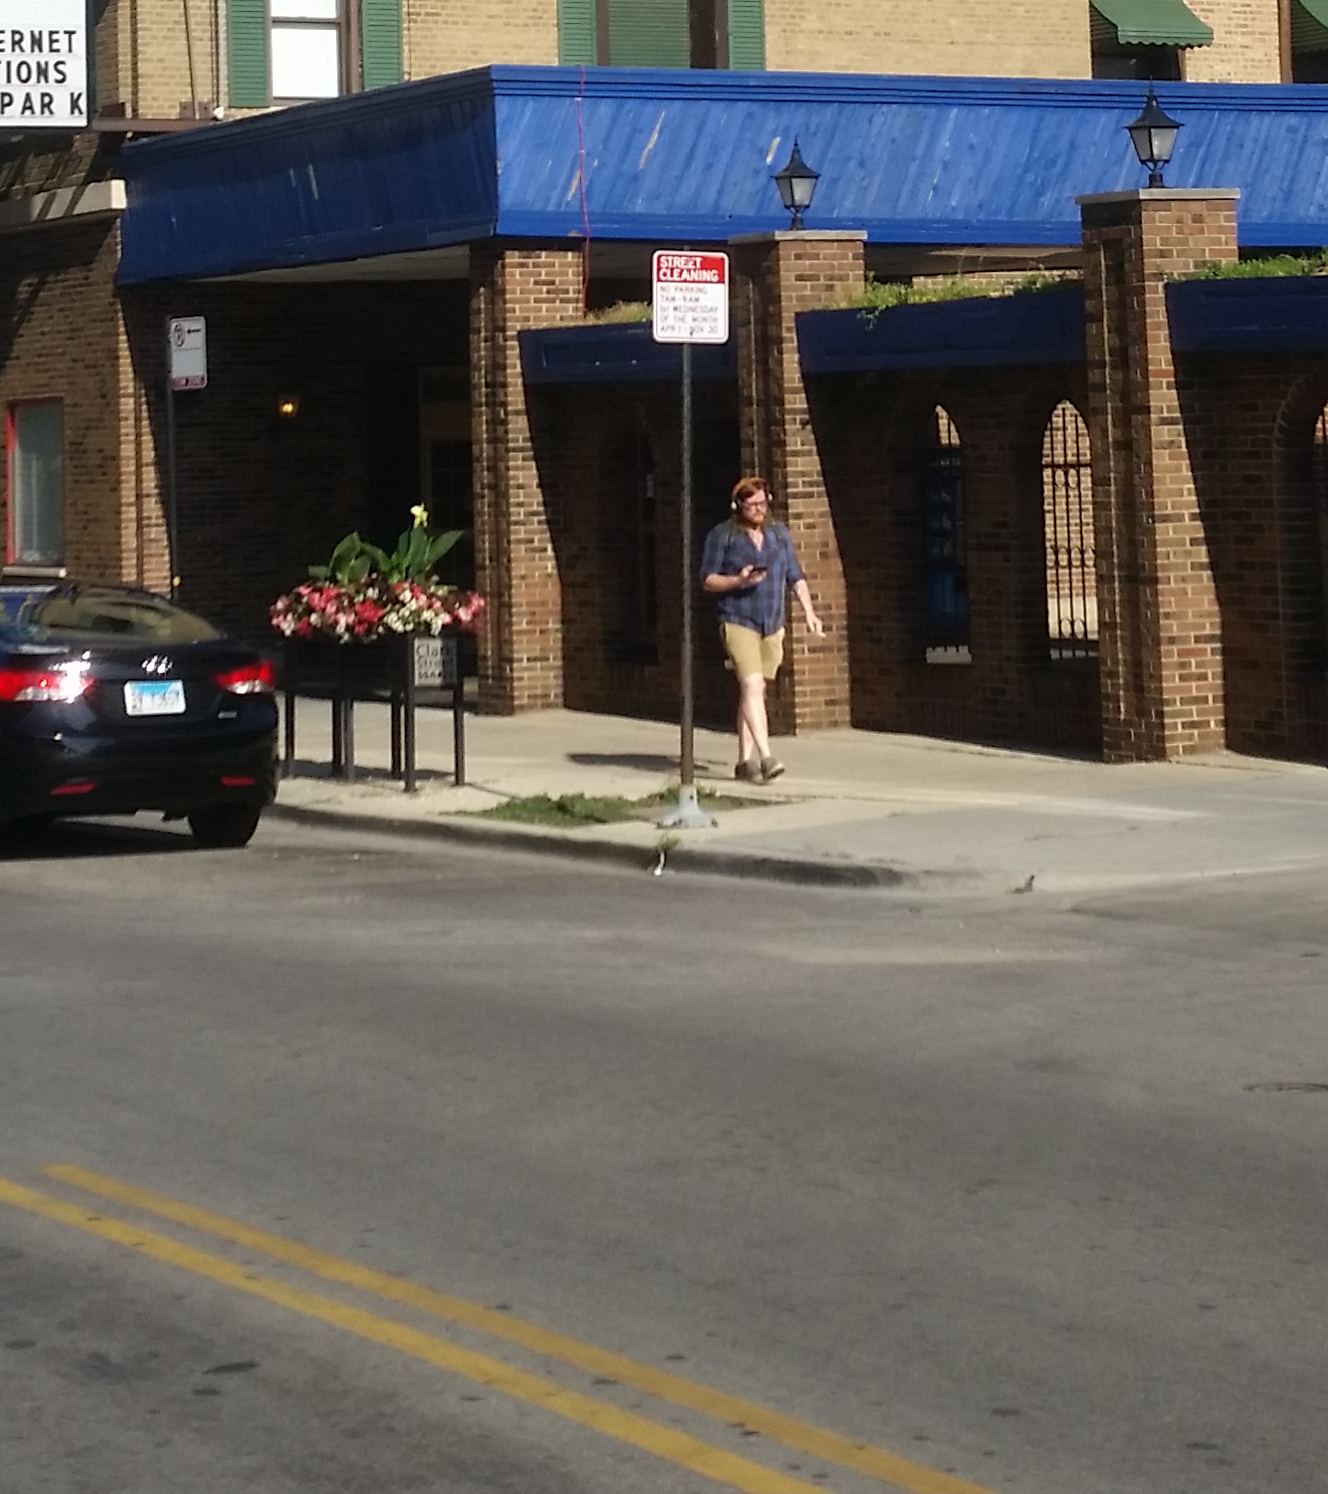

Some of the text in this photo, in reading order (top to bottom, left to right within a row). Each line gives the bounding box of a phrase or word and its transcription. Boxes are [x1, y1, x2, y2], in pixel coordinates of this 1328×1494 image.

[660, 256, 702, 269] STREET
[659, 269, 719, 282] CLEANING
[660, 285, 707, 294] NO PARKING
[673, 304, 719, 313] WEDNESDAY
[692, 315, 718, 323] MONTH
